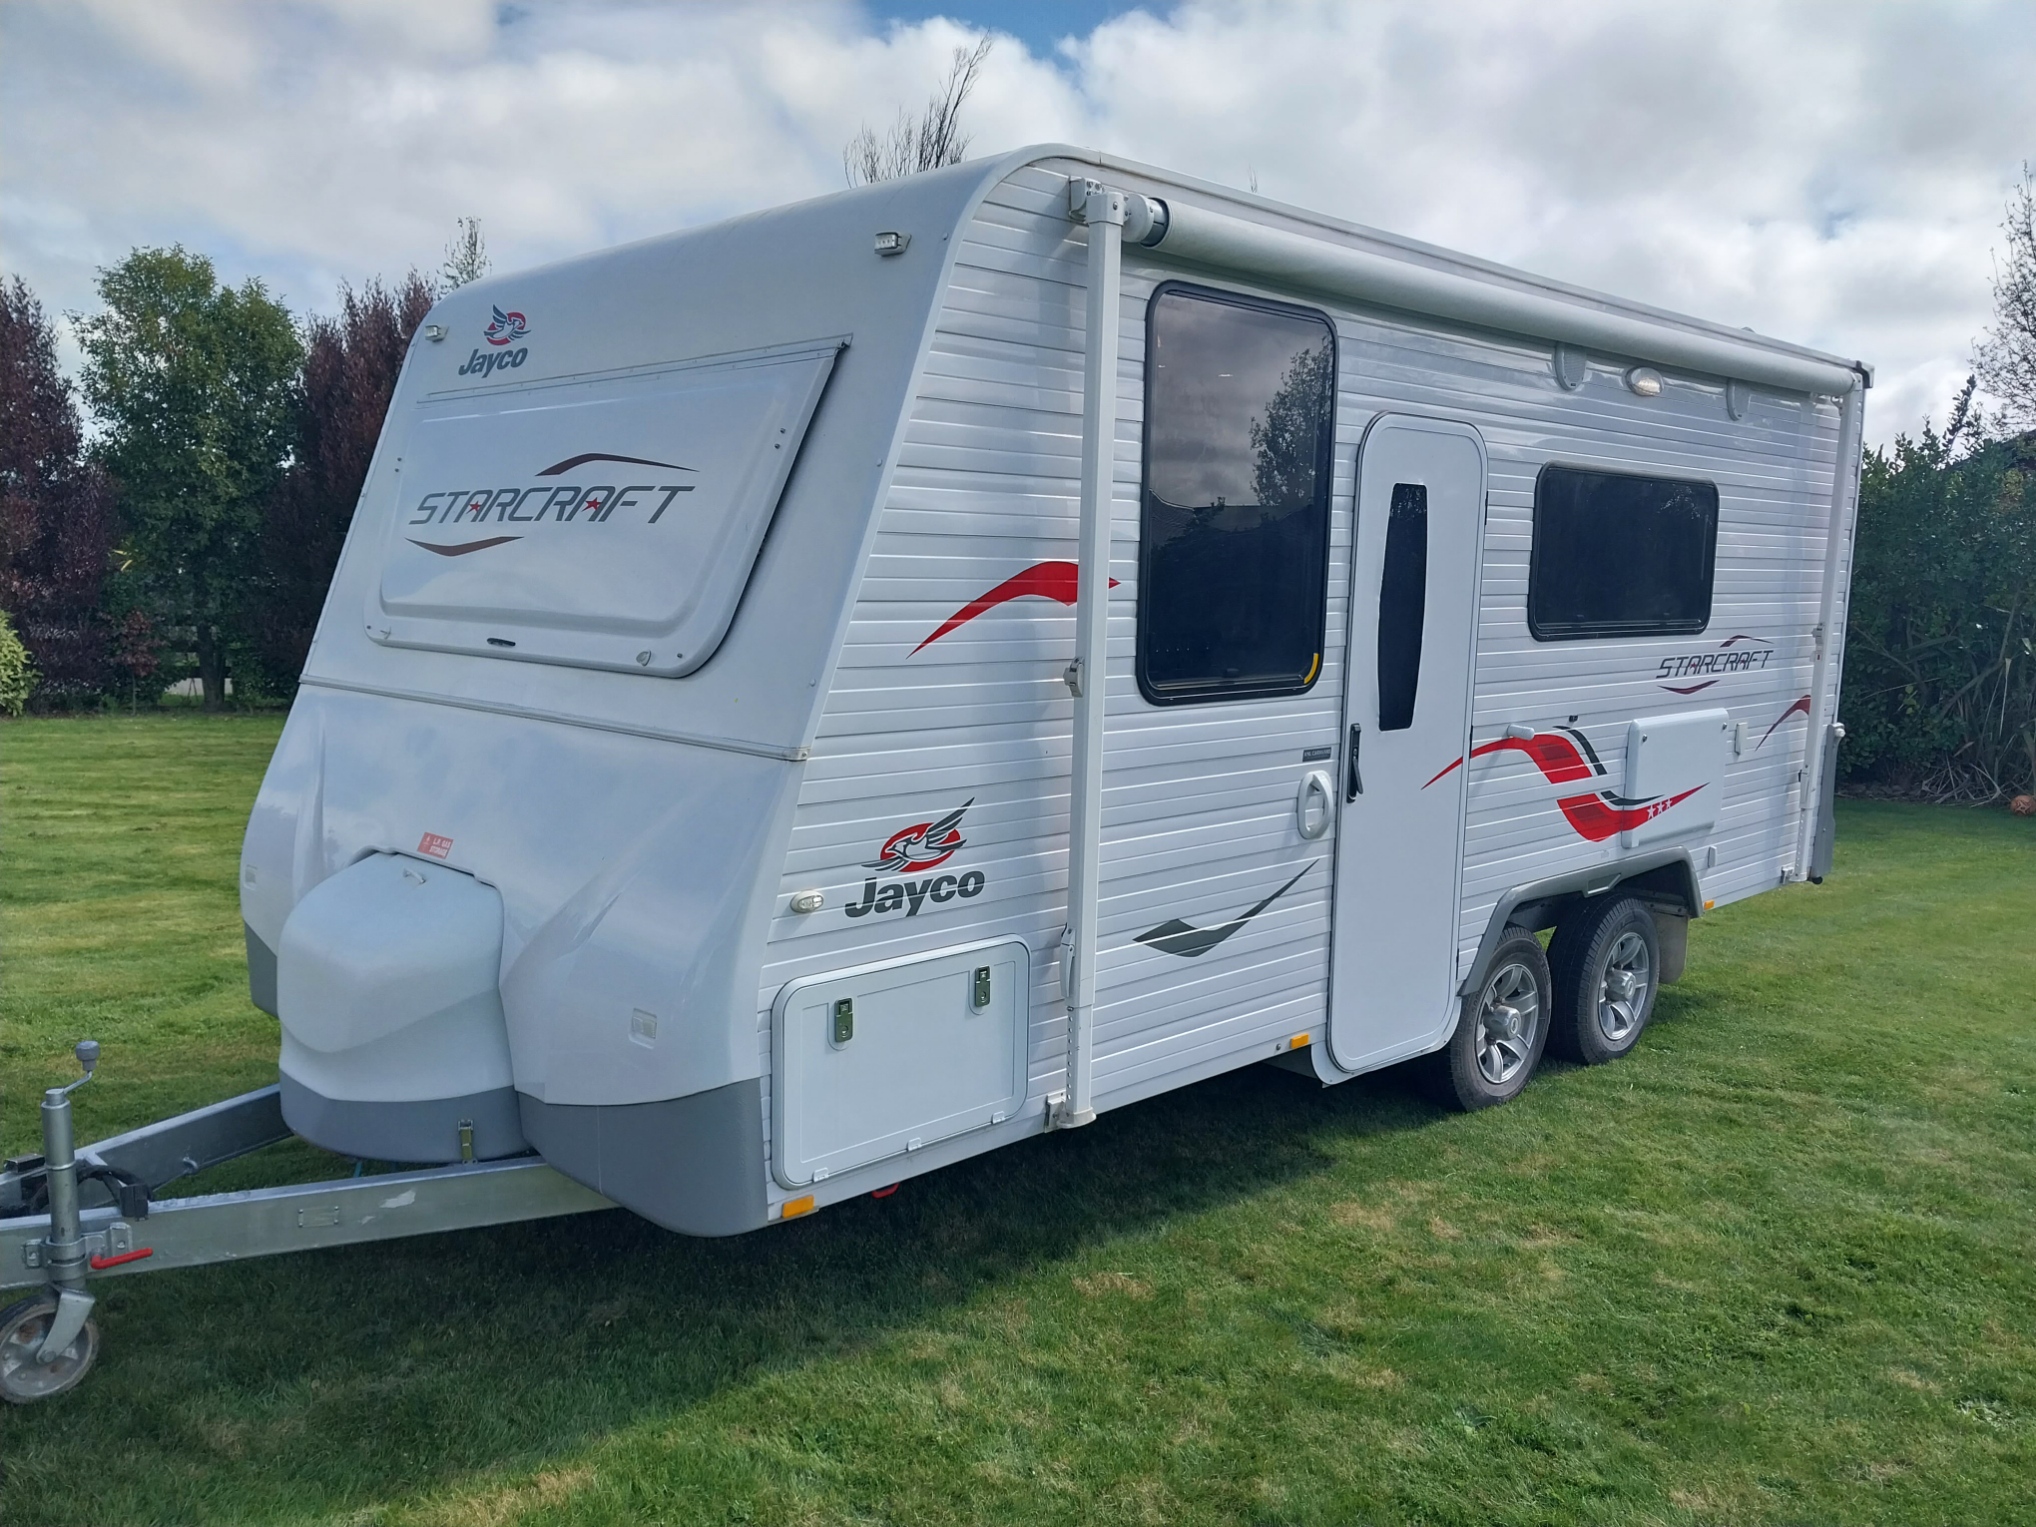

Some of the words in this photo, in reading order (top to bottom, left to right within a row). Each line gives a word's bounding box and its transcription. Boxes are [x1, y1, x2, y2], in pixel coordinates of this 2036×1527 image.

[458, 347, 528, 378] Jayco
[408, 485, 696, 525] STARCRAFT
[1656, 650, 1774, 679] STARCRAFT
[845, 870, 985, 918] Jayco
